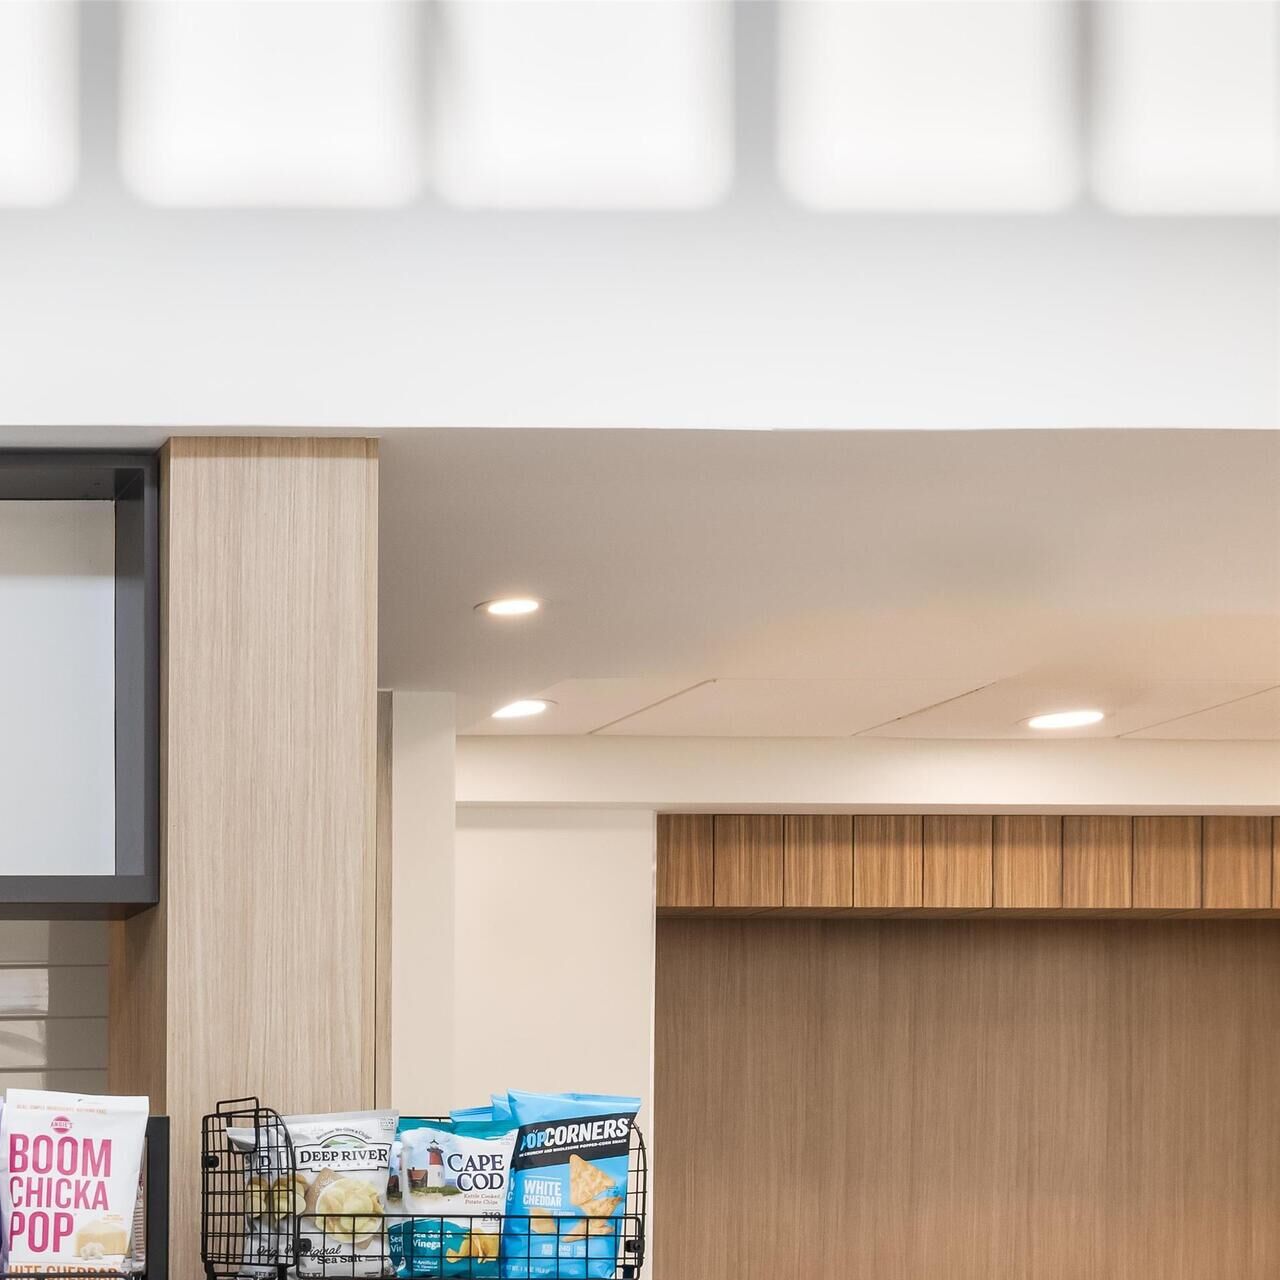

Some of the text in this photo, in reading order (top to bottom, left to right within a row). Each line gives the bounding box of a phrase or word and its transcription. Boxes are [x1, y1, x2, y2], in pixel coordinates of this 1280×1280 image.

[9, 1134, 112, 1178] BOOM
[300, 1149, 388, 1163] DEEP RIVER
[447, 1153, 505, 1172] CAPE
[456, 1173, 504, 1191] COD
[524, 1179, 562, 1196] WHITE
[9, 1176, 109, 1211] CHICKA
[523, 1195, 562, 1208] CHEDDAR
[9, 1212, 74, 1253] POP
